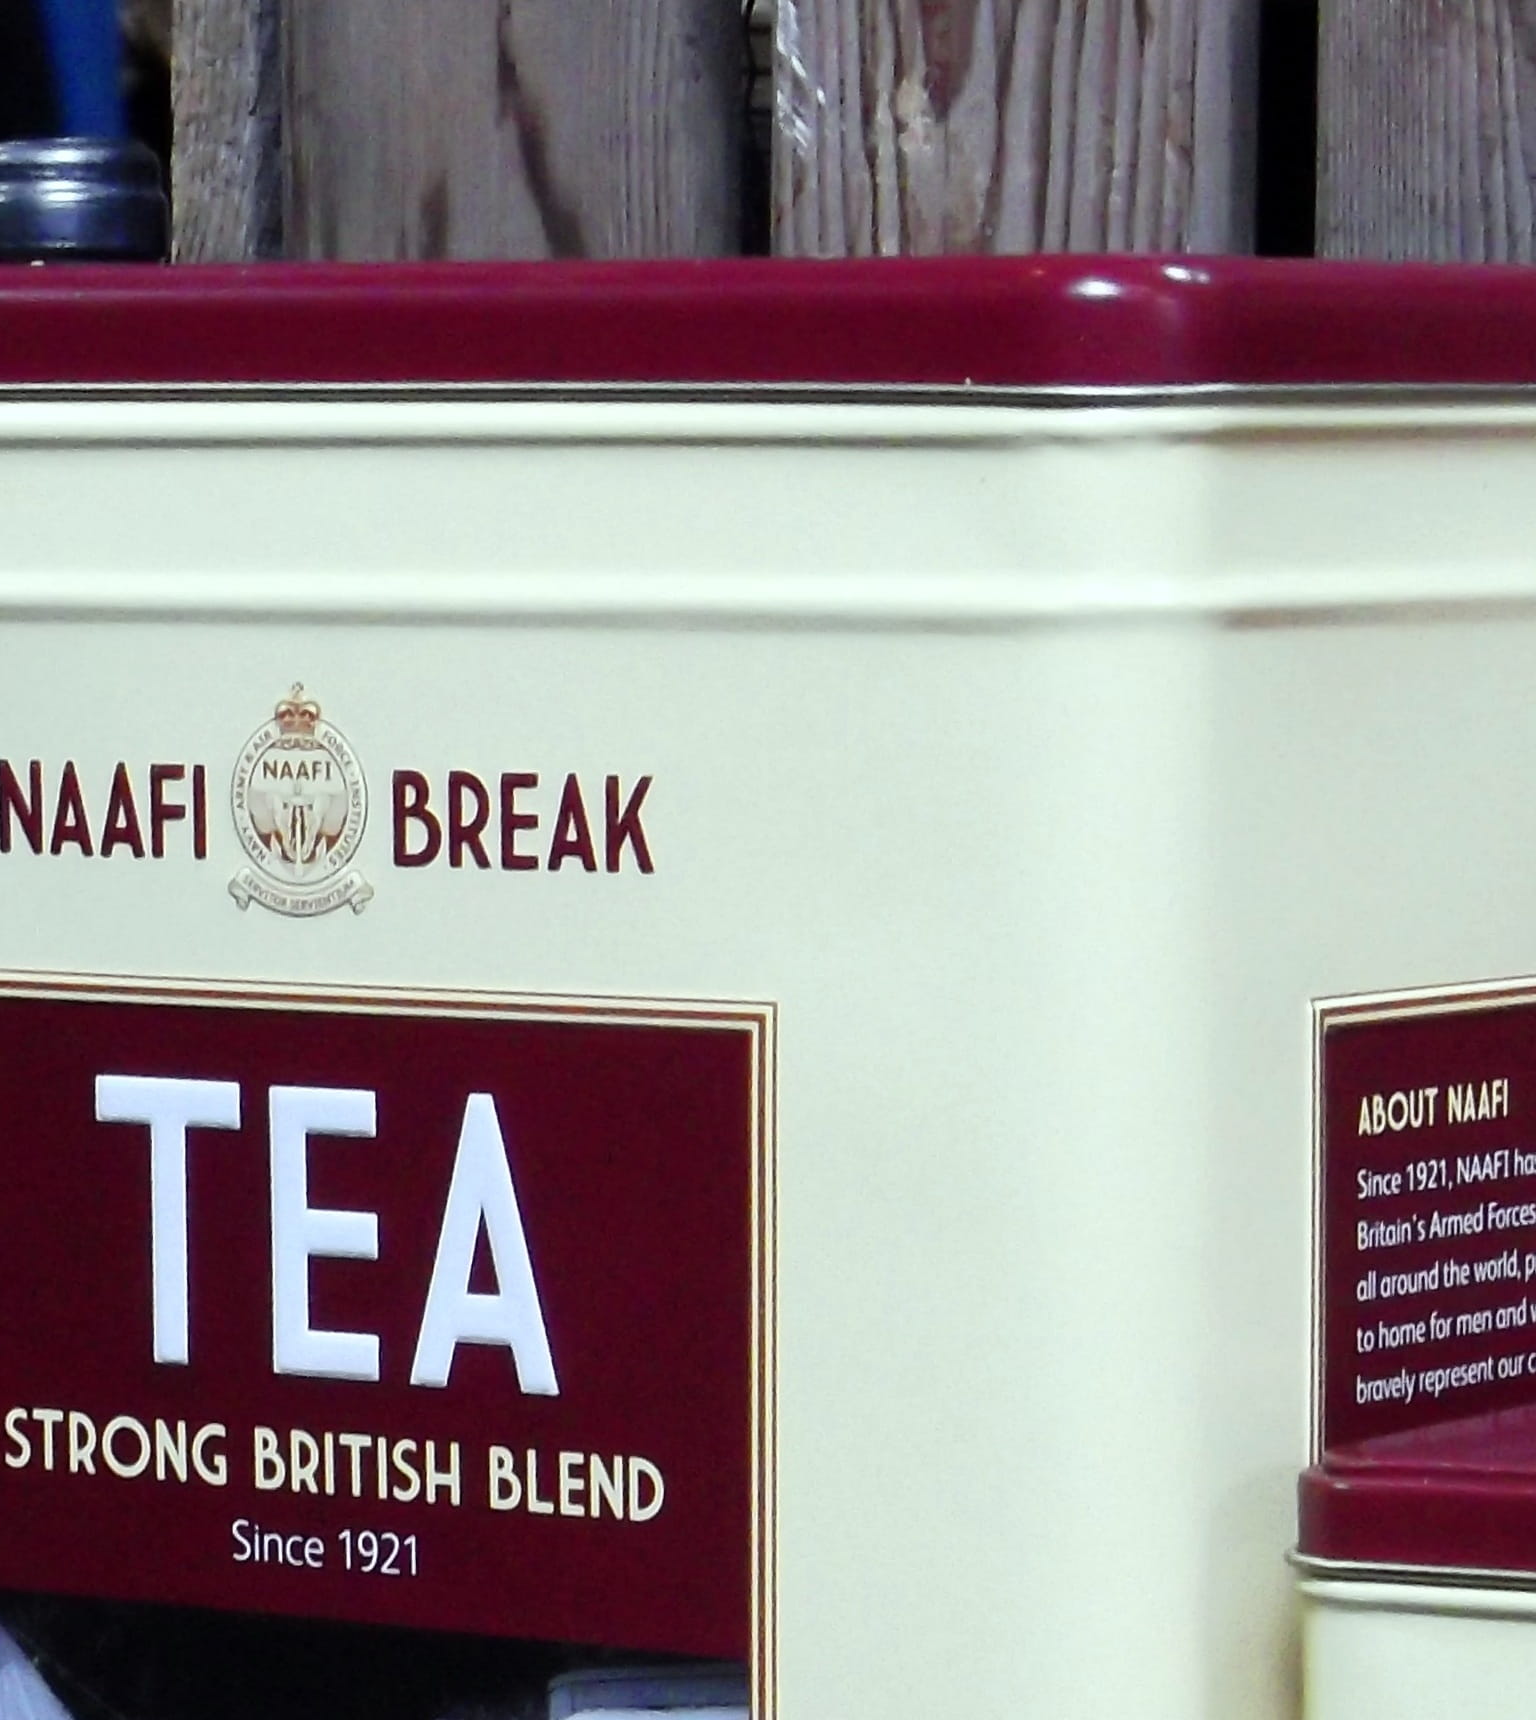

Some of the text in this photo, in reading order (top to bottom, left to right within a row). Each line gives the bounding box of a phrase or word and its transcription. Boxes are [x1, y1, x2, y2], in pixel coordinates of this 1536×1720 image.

[263, 760, 332, 781] NAAFI
[393, 769, 657, 875] BREAK
[1358, 1077, 1509, 1137] ABOUT NAAFI
[1357, 1168, 1402, 1200] Since
[1406, 1157, 1453, 1191] 1921,
[1457, 1148, 1510, 1185] NAAFI
[94, 1074, 561, 1397] TEA
[1357, 1213, 1426, 1251] Britain's
[1429, 1203, 1484, 1240] Armed
[1357, 1270, 1376, 1301] all
[1380, 1260, 1439, 1298] around
[1443, 1259, 1470, 1288] the
[1474, 1248, 1521, 1283] world,
[1357, 1328, 1375, 1353] to
[1379, 1320, 1427, 1350] home
[1430, 1310, 1454, 1341] for
[1456, 1309, 1493, 1336] men
[1495, 1296, 1528, 1330] and
[1356, 1368, 1416, 1405] bravely
[1419, 1356, 1495, 1398] represent
[1498, 1352, 1526, 1379] our
[5, 1406, 665, 1522] STRONG BRITISH BLEND
[232, 1519, 419, 1576] Since 1921
